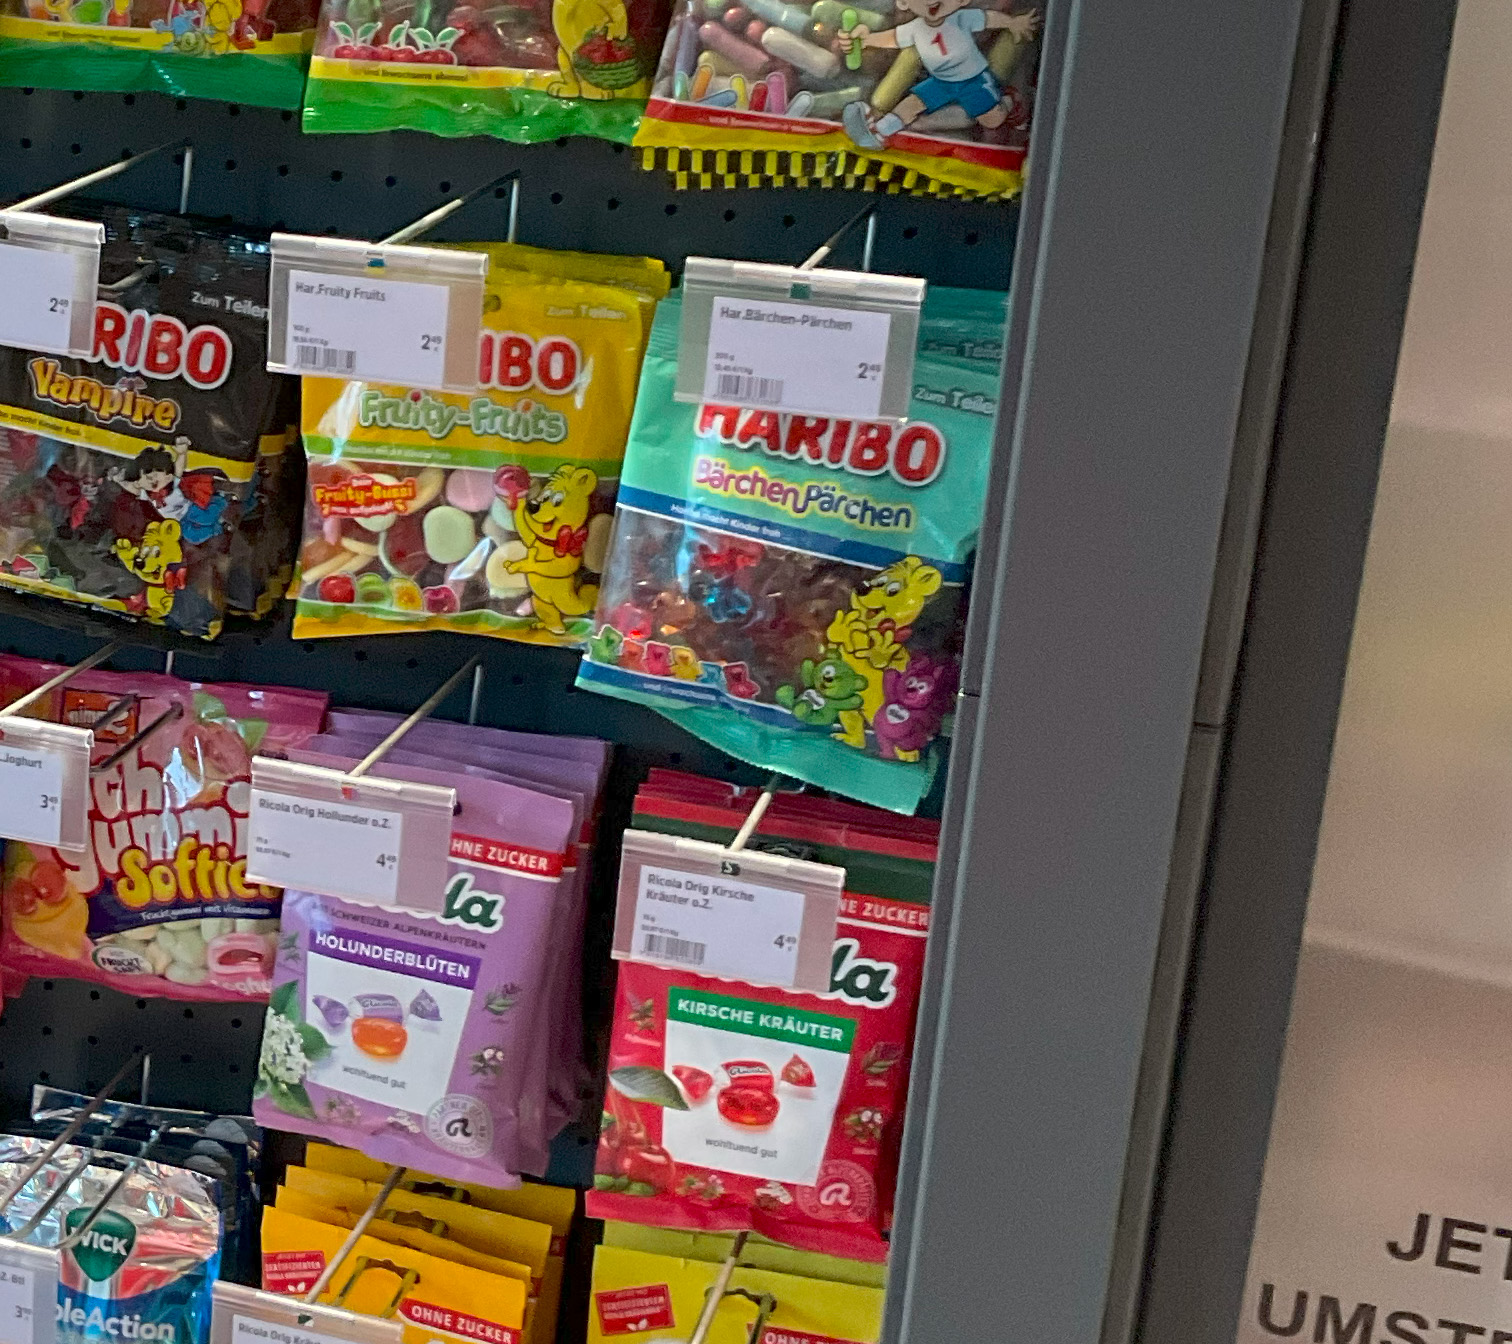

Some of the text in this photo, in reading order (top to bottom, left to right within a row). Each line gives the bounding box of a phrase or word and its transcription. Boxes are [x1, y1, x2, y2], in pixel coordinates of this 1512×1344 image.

[191, 290, 270, 319] Zum Teilen
[295, 281, 387, 303] Har.Fruity Fruits
[719, 306, 854, 333] Har.Bärchen-Pärchen
[28, 357, 184, 433] Vampire
[913, 384, 946, 404] Zum
[357, 390, 569, 445] Fruity-Fruits
[258, 799, 367, 826] Ricola Orig Hollunder
[484, 844, 549, 872] ZUCKER
[116, 838, 279, 910] Softie
[645, 890, 689, 909] Kräuter
[647, 874, 755, 903] Ricola Orig Kirsche
[863, 904, 929, 928] ZUCKER
[314, 931, 471, 980] HOLUNDERBLÜTEN
[677, 998, 844, 1042] KIRSCHE KRÄUTER
[342, 1063, 389, 1085] wohltuend
[704, 1137, 759, 1158] wohltuend
[72, 1232, 130, 1257] WICK
[238, 1320, 267, 1337] Ricola
[269, 1326, 292, 1344] Orig
[410, 1302, 513, 1344] OHNE ZUCKER
